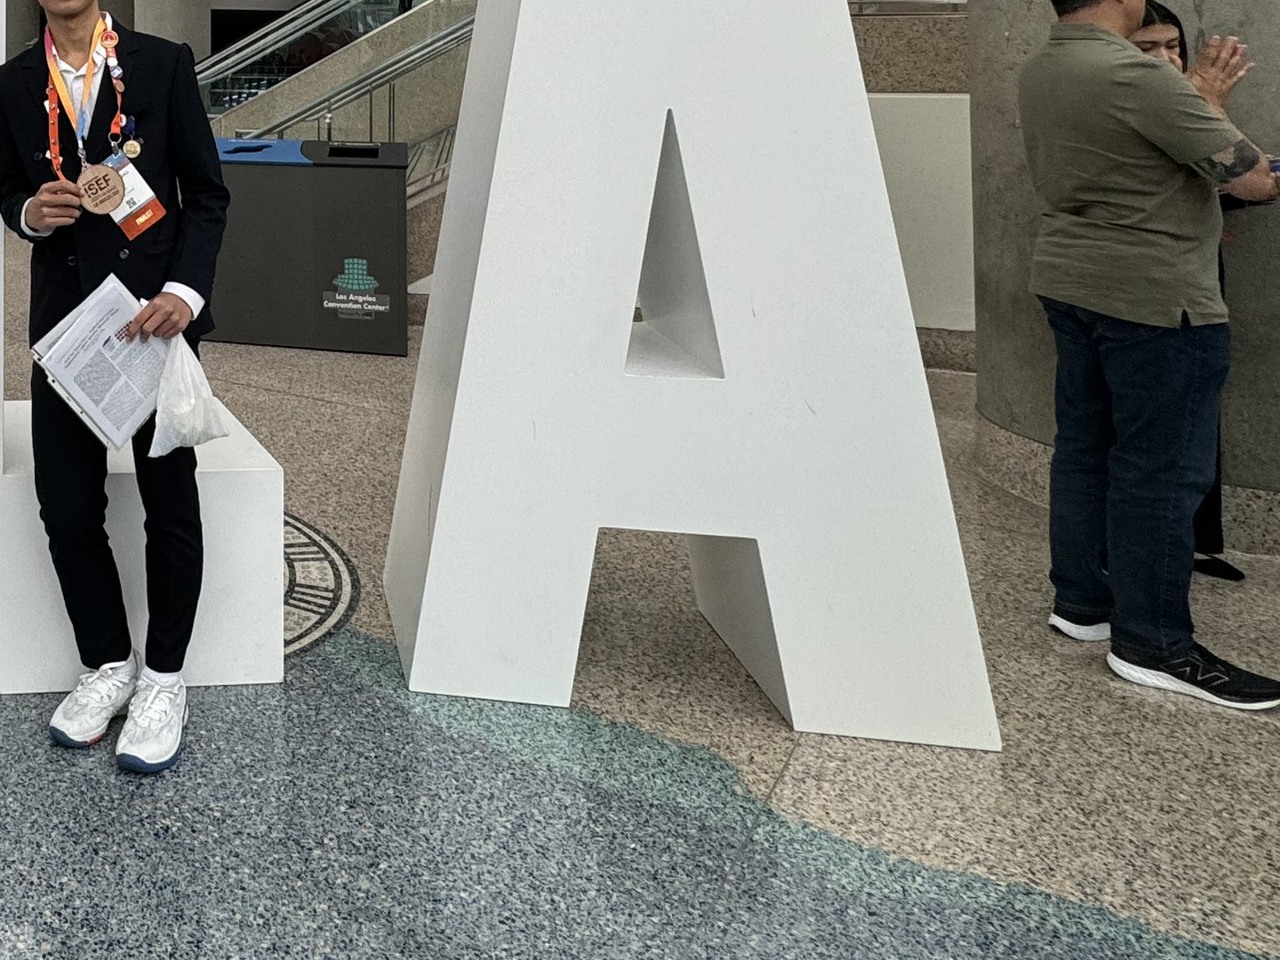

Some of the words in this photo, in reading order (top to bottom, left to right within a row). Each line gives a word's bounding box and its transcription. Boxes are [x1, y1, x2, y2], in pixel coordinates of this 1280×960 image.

[83, 173, 111, 198] ISEF
[335, 292, 347, 300] Los
[349, 293, 376, 302] Angeles
[323, 300, 362, 309] Convention
